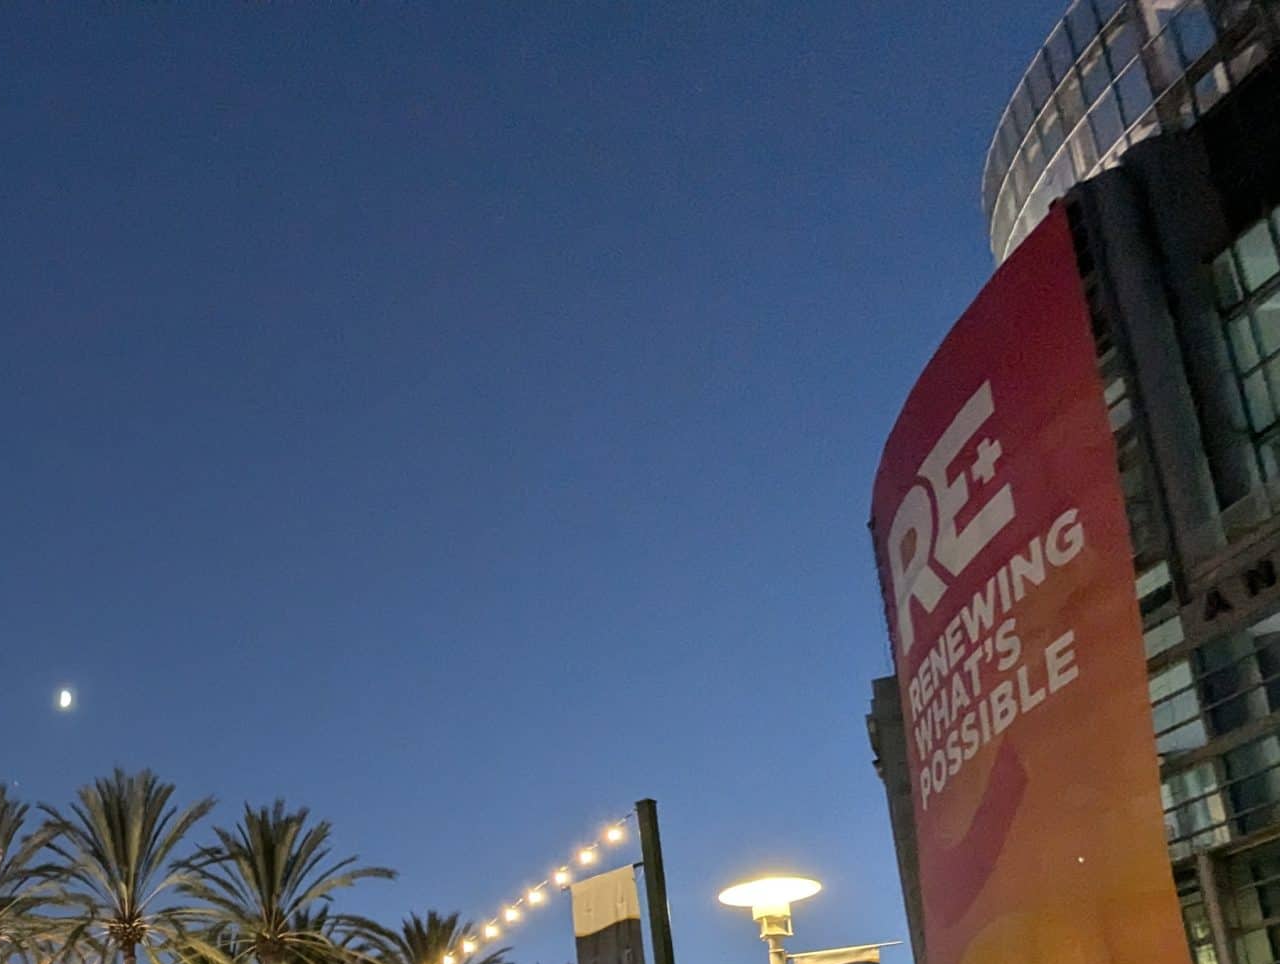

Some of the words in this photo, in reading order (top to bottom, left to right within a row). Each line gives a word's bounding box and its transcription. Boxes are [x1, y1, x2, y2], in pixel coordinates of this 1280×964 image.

[909, 508, 1084, 722] RENEWING
[915, 618, 1021, 761] WHAT'S
[921, 630, 1079, 810] POSSIBLE
